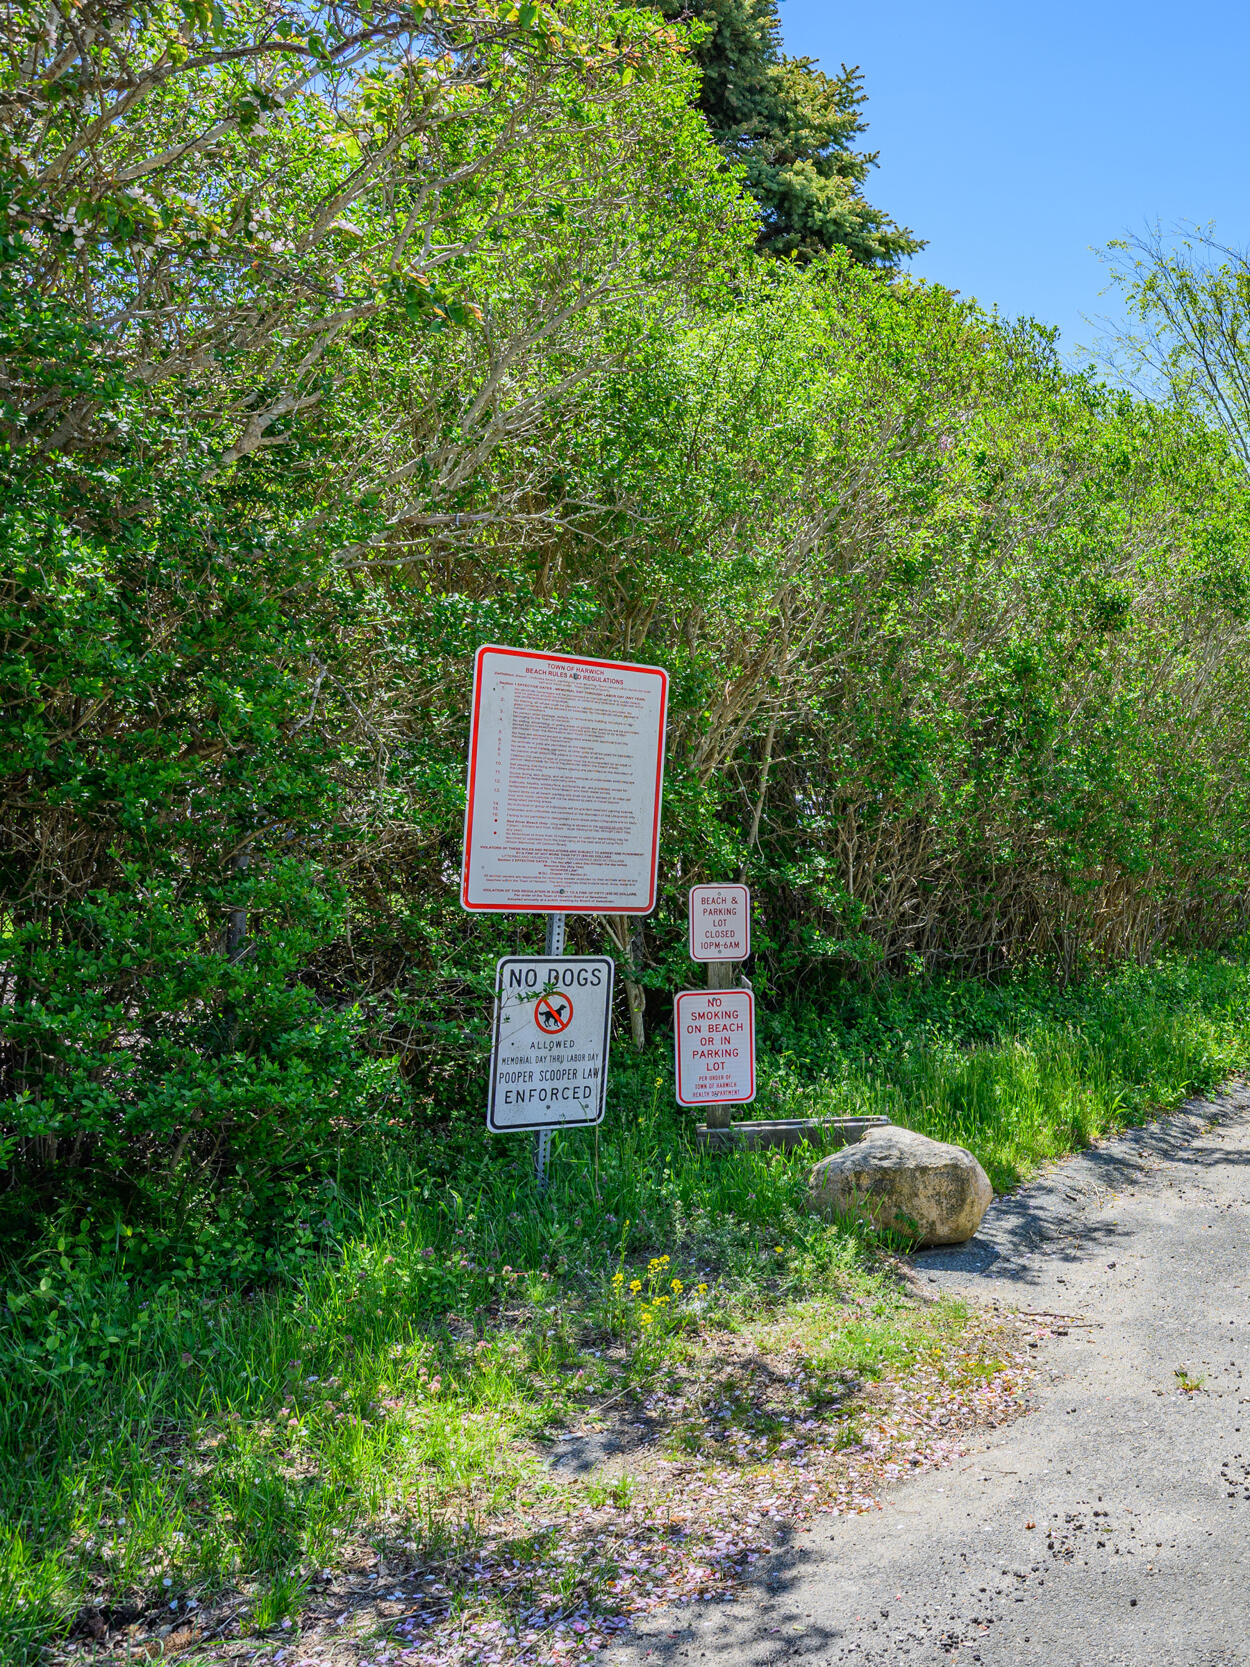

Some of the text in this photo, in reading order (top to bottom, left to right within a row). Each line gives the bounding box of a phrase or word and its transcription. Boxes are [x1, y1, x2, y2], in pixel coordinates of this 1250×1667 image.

[576, 666, 604, 676] HARWICH
[548, 670, 568, 678] RULES
[583, 675, 624, 686] REGULATIONS
[701, 897, 727, 905] BEACH
[703, 908, 737, 916] PARKING
[713, 919, 727, 927] LOT
[705, 930, 735, 938] CLOSED
[701, 941, 740, 950] 10PM-6AM
[510, 968, 601, 988] NO DOGS
[708, 998, 722, 1007] NO
[691, 1010, 739, 1021] SMOKING
[687, 1023, 743, 1034] ON BEACH
[530, 1040, 575, 1050] ALLOWED
[700, 1036, 731, 1046] OR IN
[692, 1048, 739, 1059] PARKING
[502, 1053, 599, 1066] MEMORIAL DAY THRU LABOR DAY
[706, 1062, 726, 1072] LOT
[499, 1067, 599, 1084] POOPER SCOOPER LAW
[505, 1086, 592, 1104] ENFORCED
